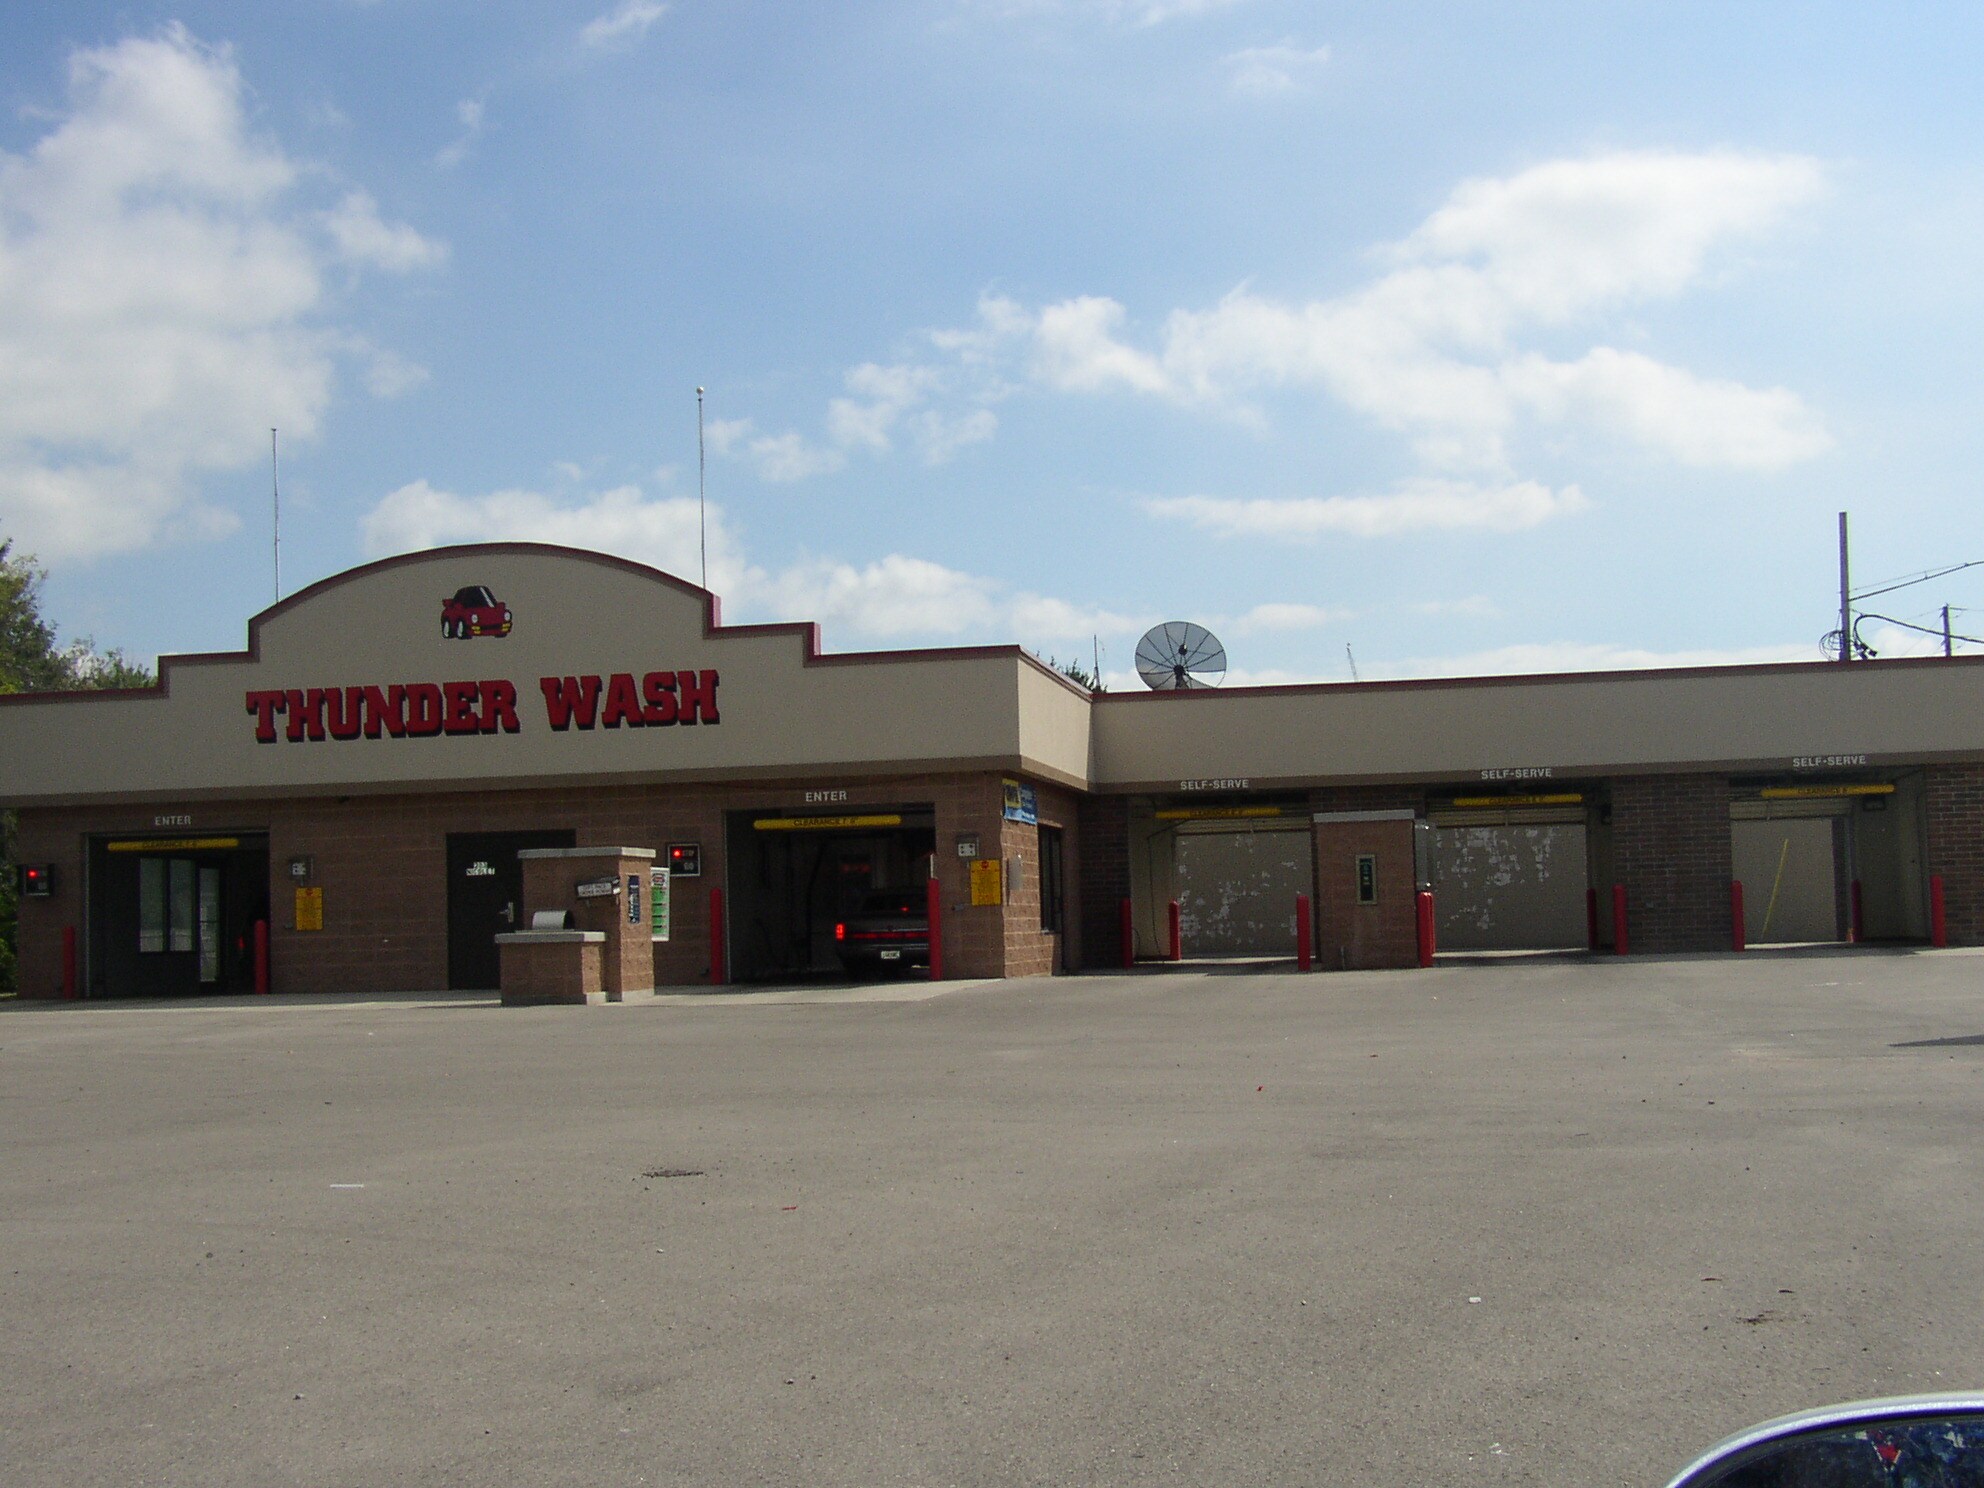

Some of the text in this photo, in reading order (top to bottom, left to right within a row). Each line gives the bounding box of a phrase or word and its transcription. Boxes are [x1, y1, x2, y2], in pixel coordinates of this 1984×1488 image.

[246, 669, 720, 743] THUNDER WASH
[1793, 756, 1867, 767] SELF-SERVE
[1481, 768, 1552, 780] SELF-SERVE
[1180, 779, 1250, 791] SELF-SERVE
[805, 790, 848, 802] ENTER
[154, 815, 192, 826] ENTER
